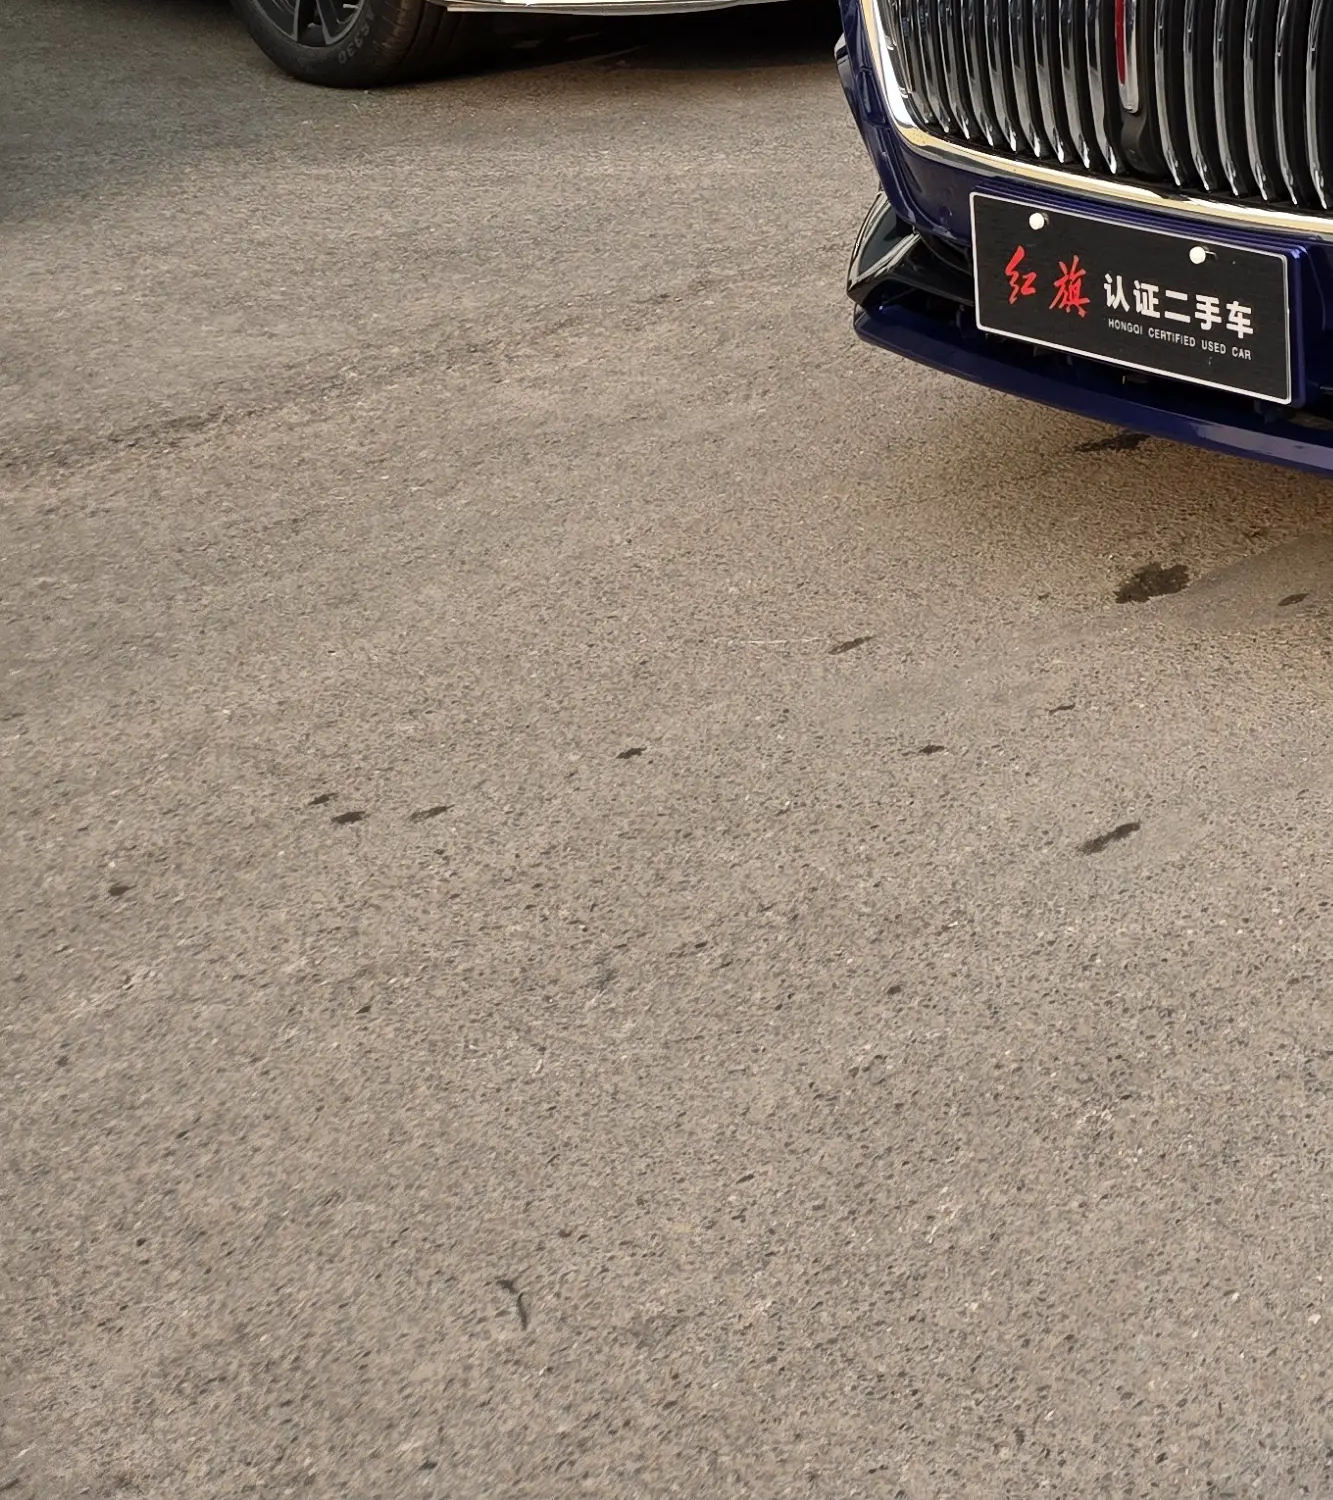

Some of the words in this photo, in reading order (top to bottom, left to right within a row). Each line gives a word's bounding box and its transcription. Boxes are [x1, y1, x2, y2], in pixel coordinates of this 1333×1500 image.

[1005, 245, 1091, 318] 红旗
[1103, 273, 1254, 339] 认证二手车
[1108, 318, 1143, 335] HONGQI
[1148, 327, 1196, 347] CERTIFIED
[1201, 339, 1227, 355] USED
[1231, 346, 1252, 361] CAR
